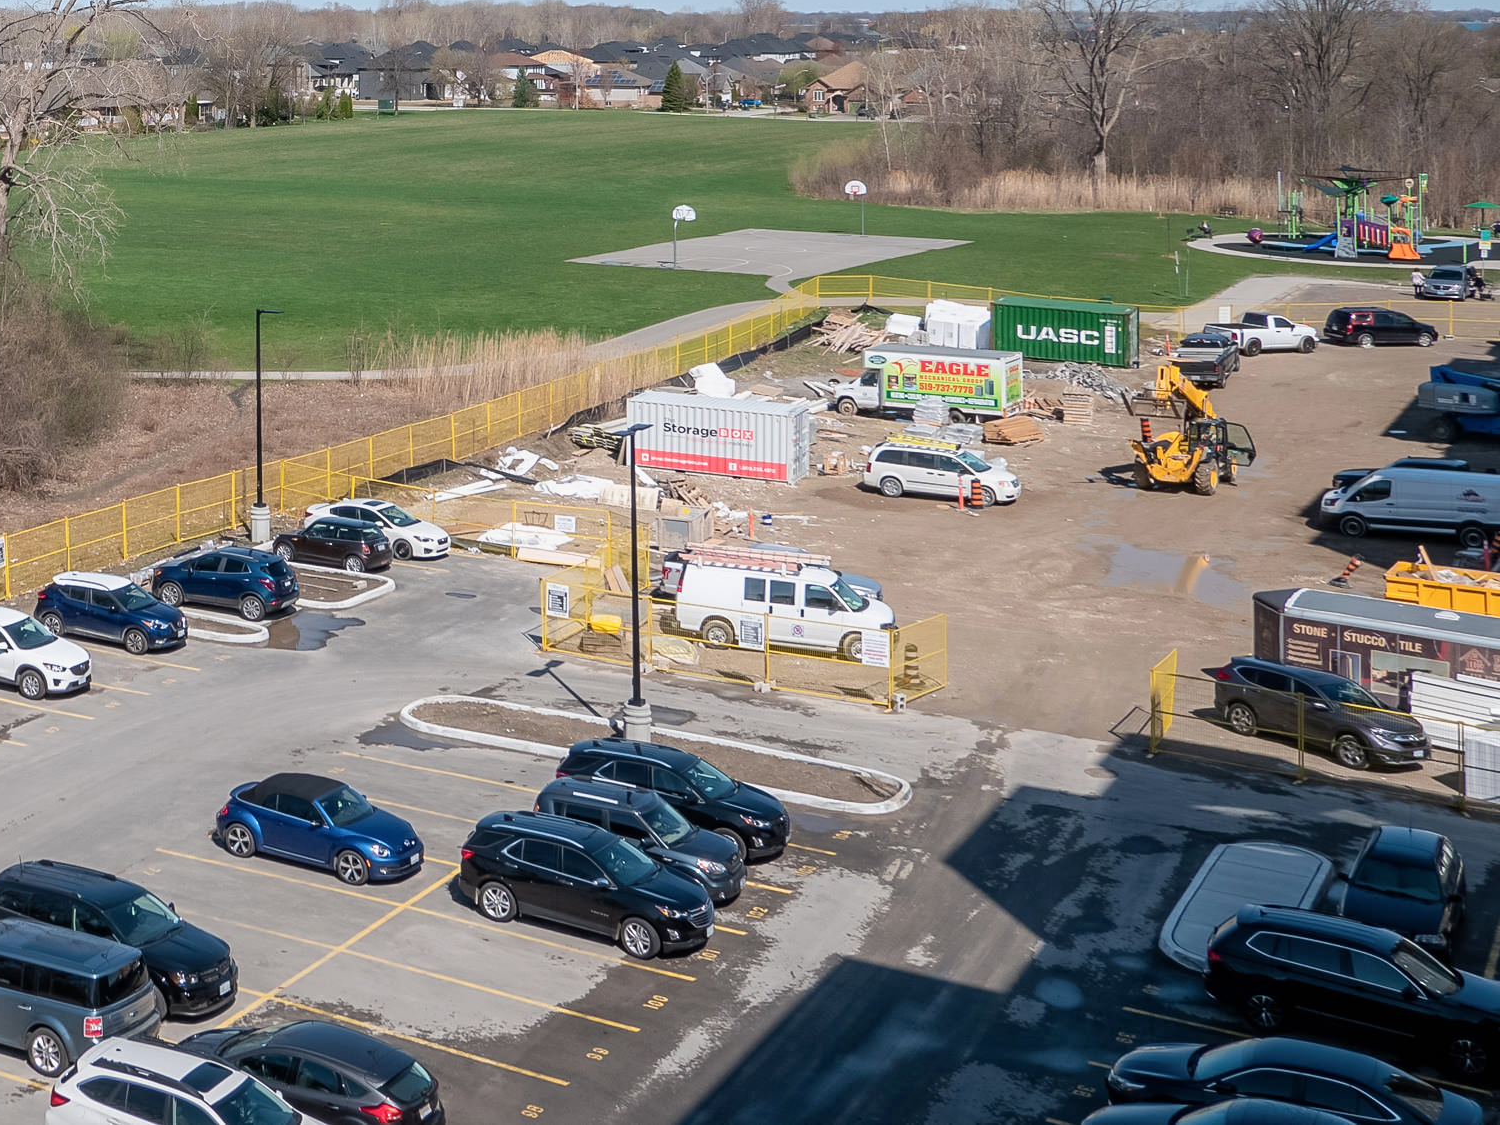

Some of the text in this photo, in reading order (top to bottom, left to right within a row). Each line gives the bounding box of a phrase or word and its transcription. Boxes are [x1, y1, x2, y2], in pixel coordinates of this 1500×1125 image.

[1016, 324, 1100, 345] UASC
[920, 360, 990, 377] EAGLE
[919, 374, 960, 383] MECHANICAL
[919, 382, 974, 395] 519-737-7778
[1293, 623, 1423, 654] STONE STUCCO TILE
[746, 906, 769, 919] 102
[697, 949, 721, 962] 101
[642, 994, 669, 1010] 100
[586, 1047, 610, 1061] 99
[521, 1104, 545, 1119] 98
